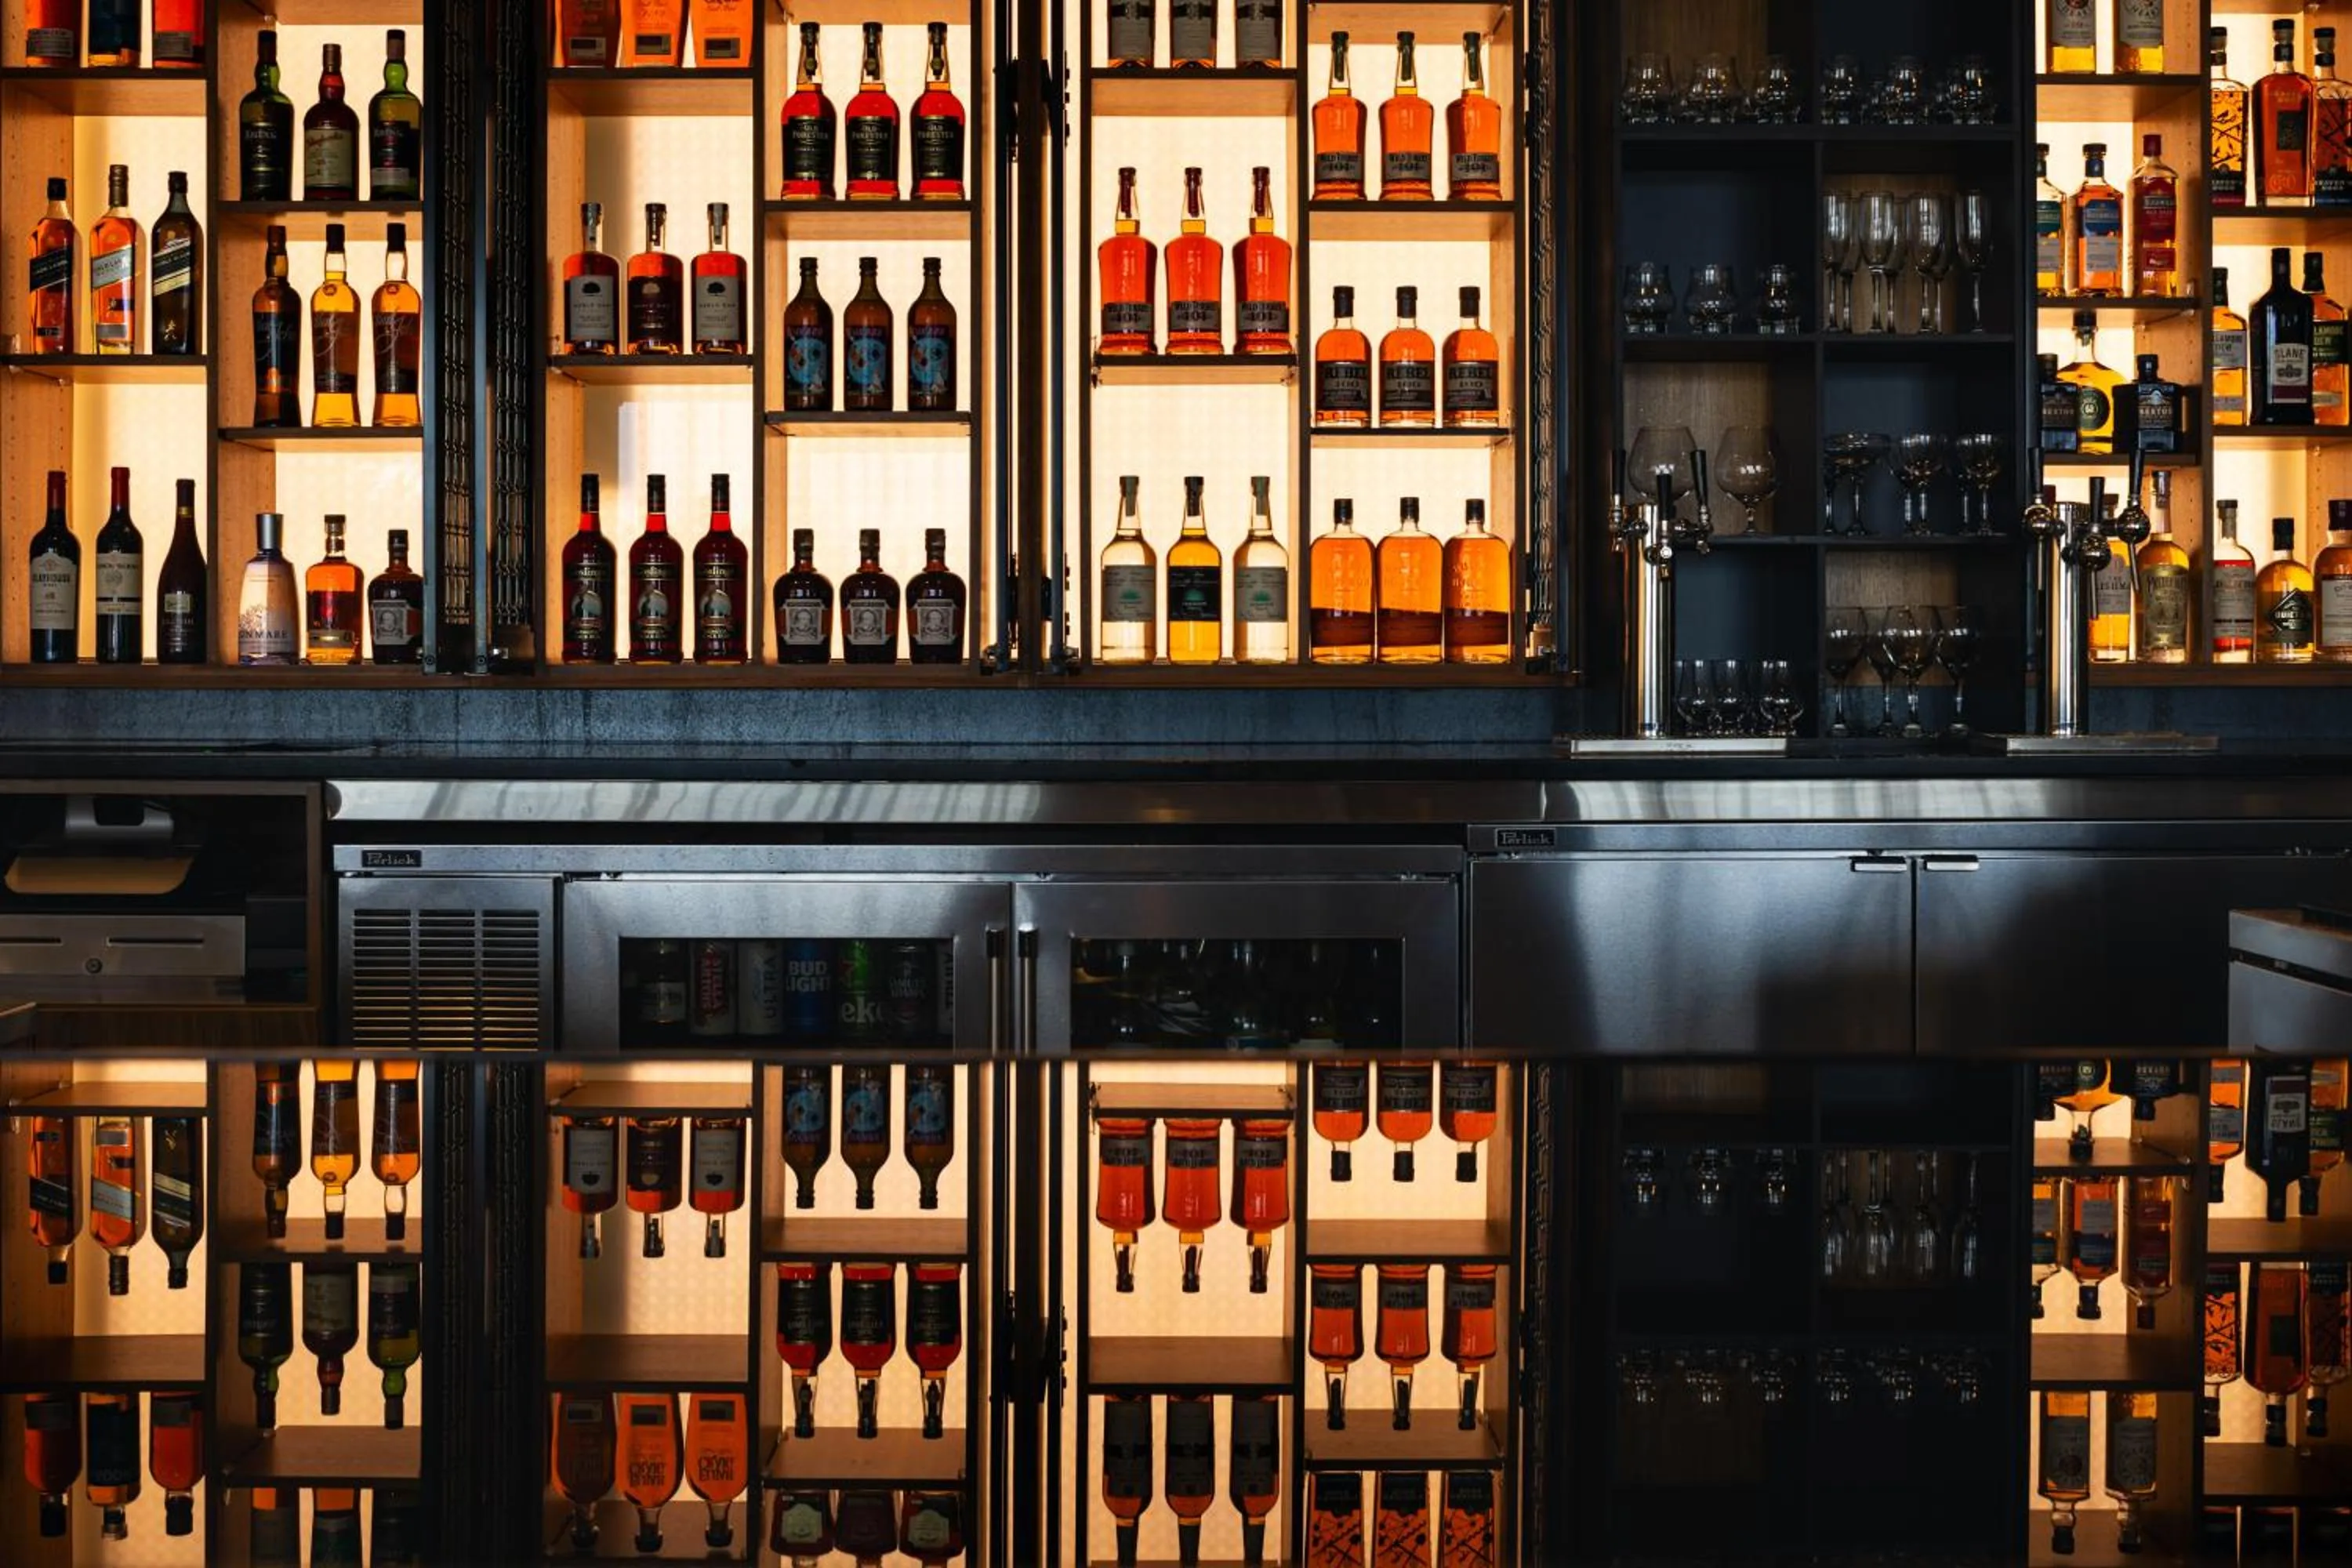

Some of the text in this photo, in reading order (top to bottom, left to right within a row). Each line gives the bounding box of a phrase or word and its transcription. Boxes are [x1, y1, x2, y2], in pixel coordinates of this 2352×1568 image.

[1387, 368, 1429, 378] REBEL
[1449, 367, 1492, 378] REBEL
[789, 960, 829, 975] BUD
